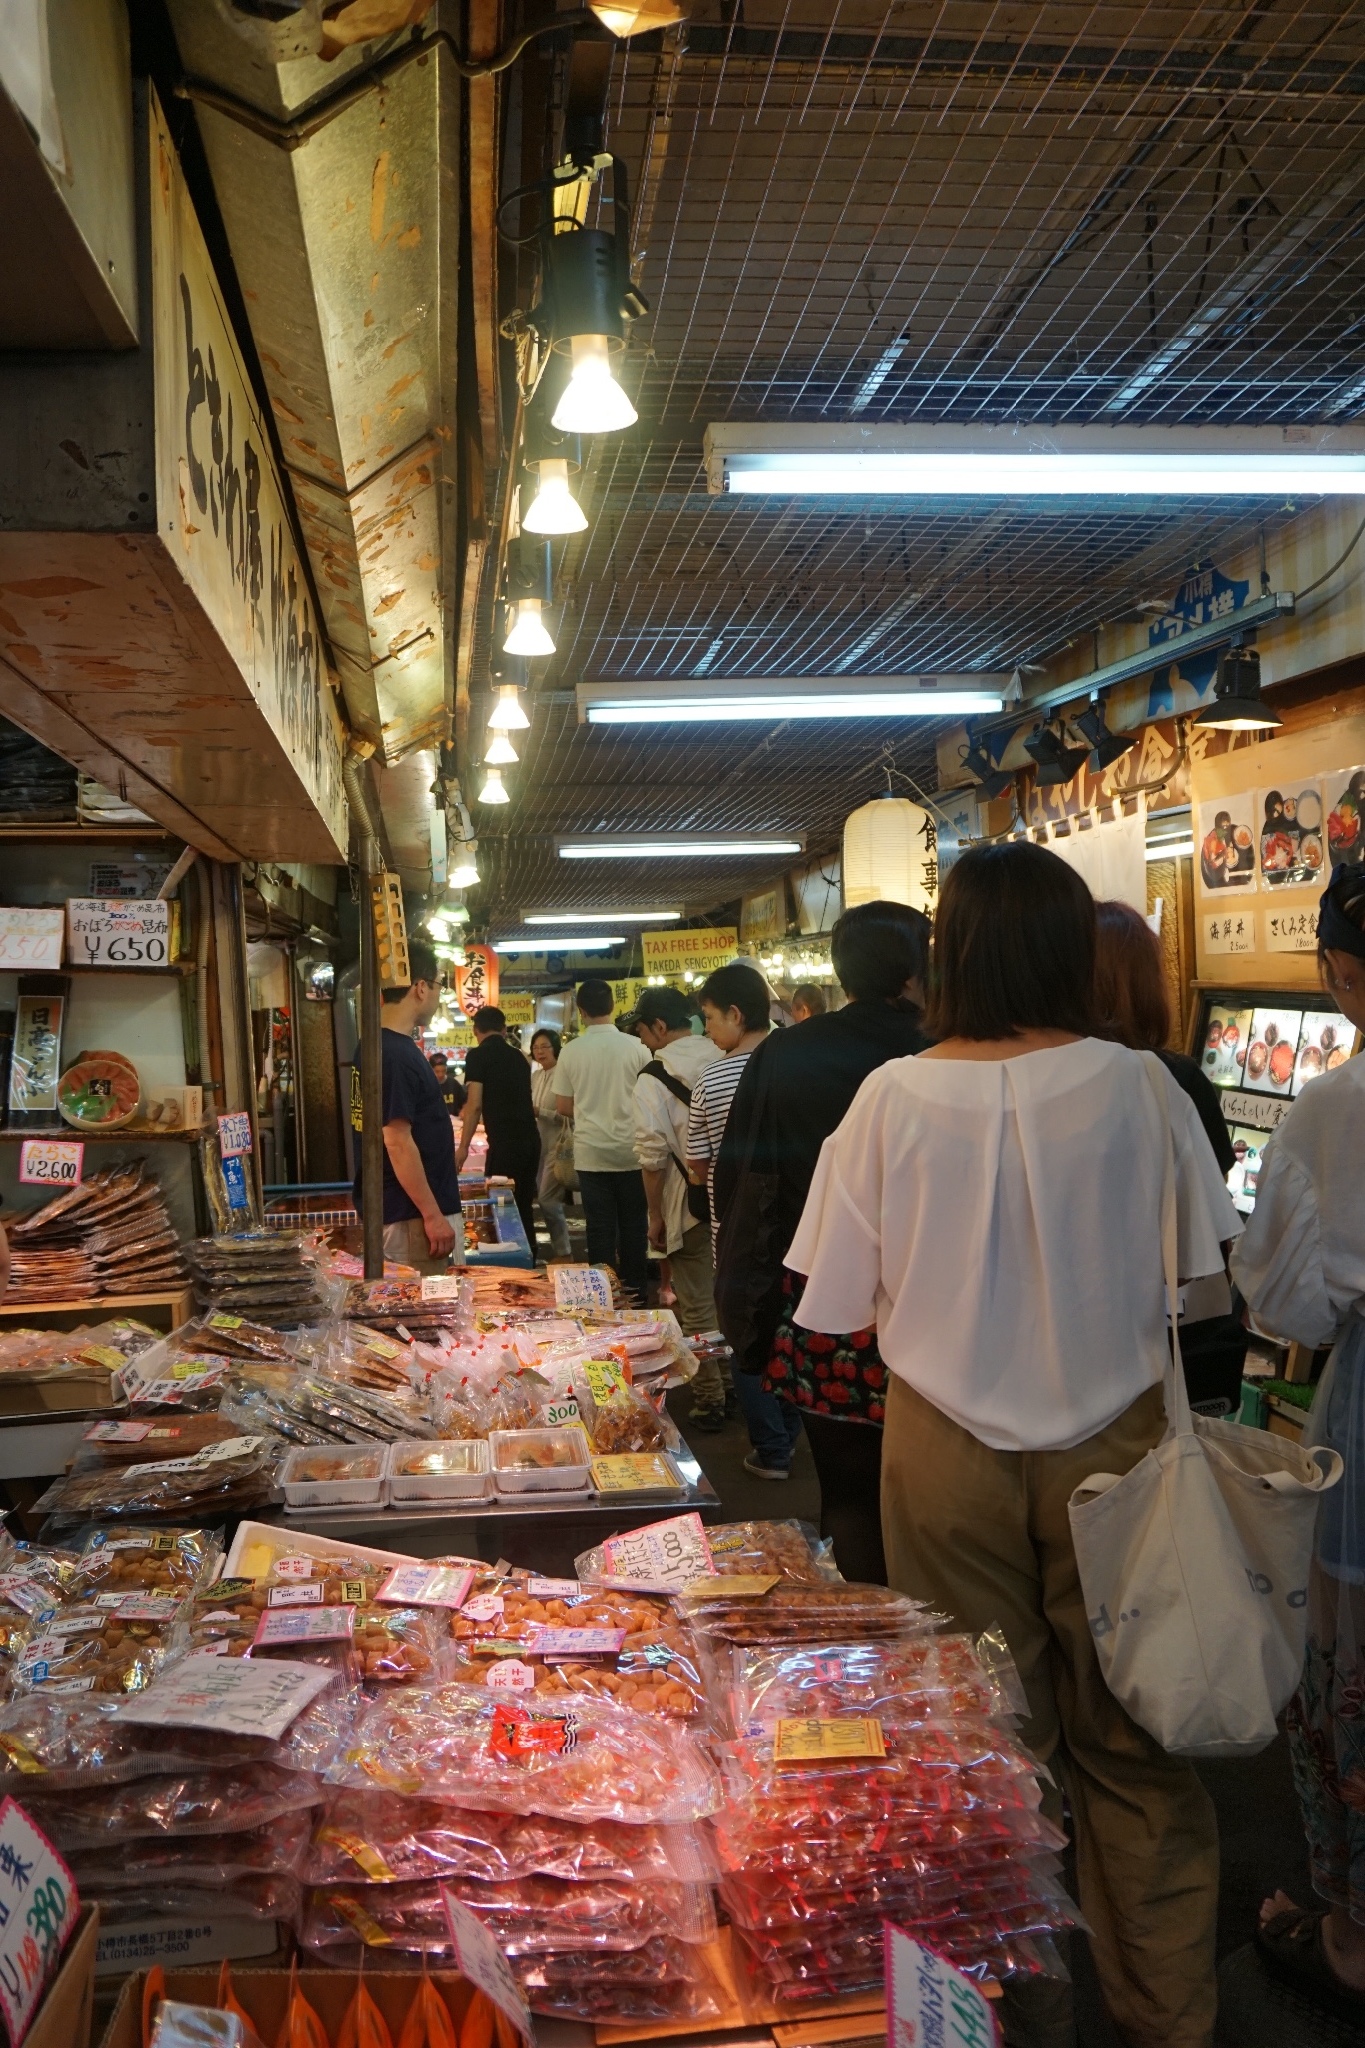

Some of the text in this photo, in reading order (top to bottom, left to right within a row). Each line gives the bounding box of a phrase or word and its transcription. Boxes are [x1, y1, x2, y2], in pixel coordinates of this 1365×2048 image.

[645, 935, 735, 954] TAX FREE SHOP
[648, 959, 680, 973] TAKEDA
